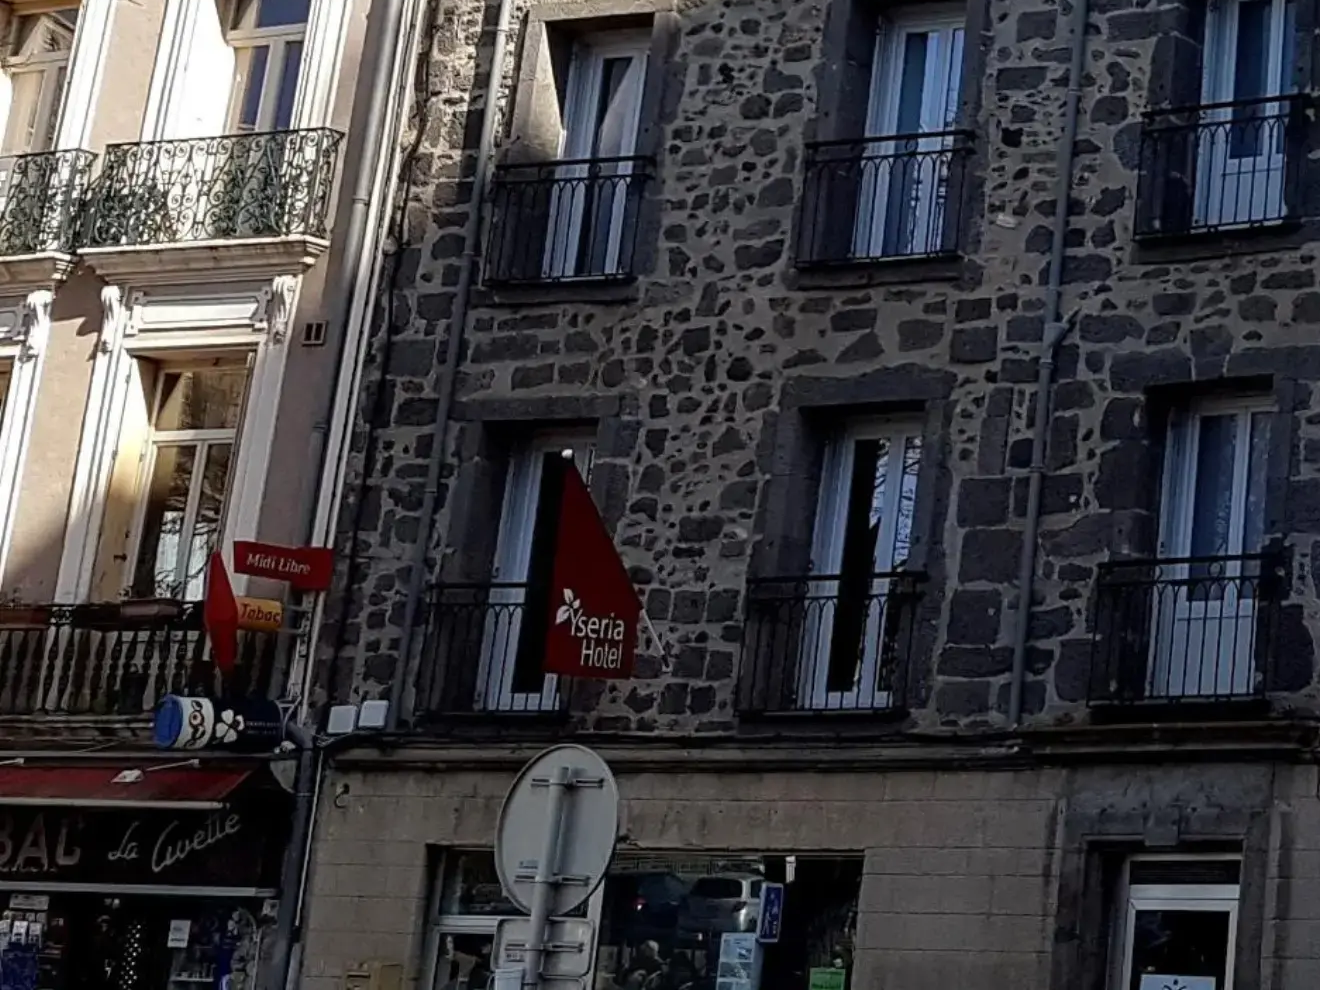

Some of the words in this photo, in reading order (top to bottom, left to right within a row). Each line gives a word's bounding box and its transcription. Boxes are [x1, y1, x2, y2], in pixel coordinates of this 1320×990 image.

[246, 553, 277, 567] Midi
[278, 557, 311, 575] Libre
[240, 603, 280, 622] Tabac
[570, 608, 625, 640] Yseria
[580, 639, 623, 669] Hotel
[108, 821, 140, 860] La
